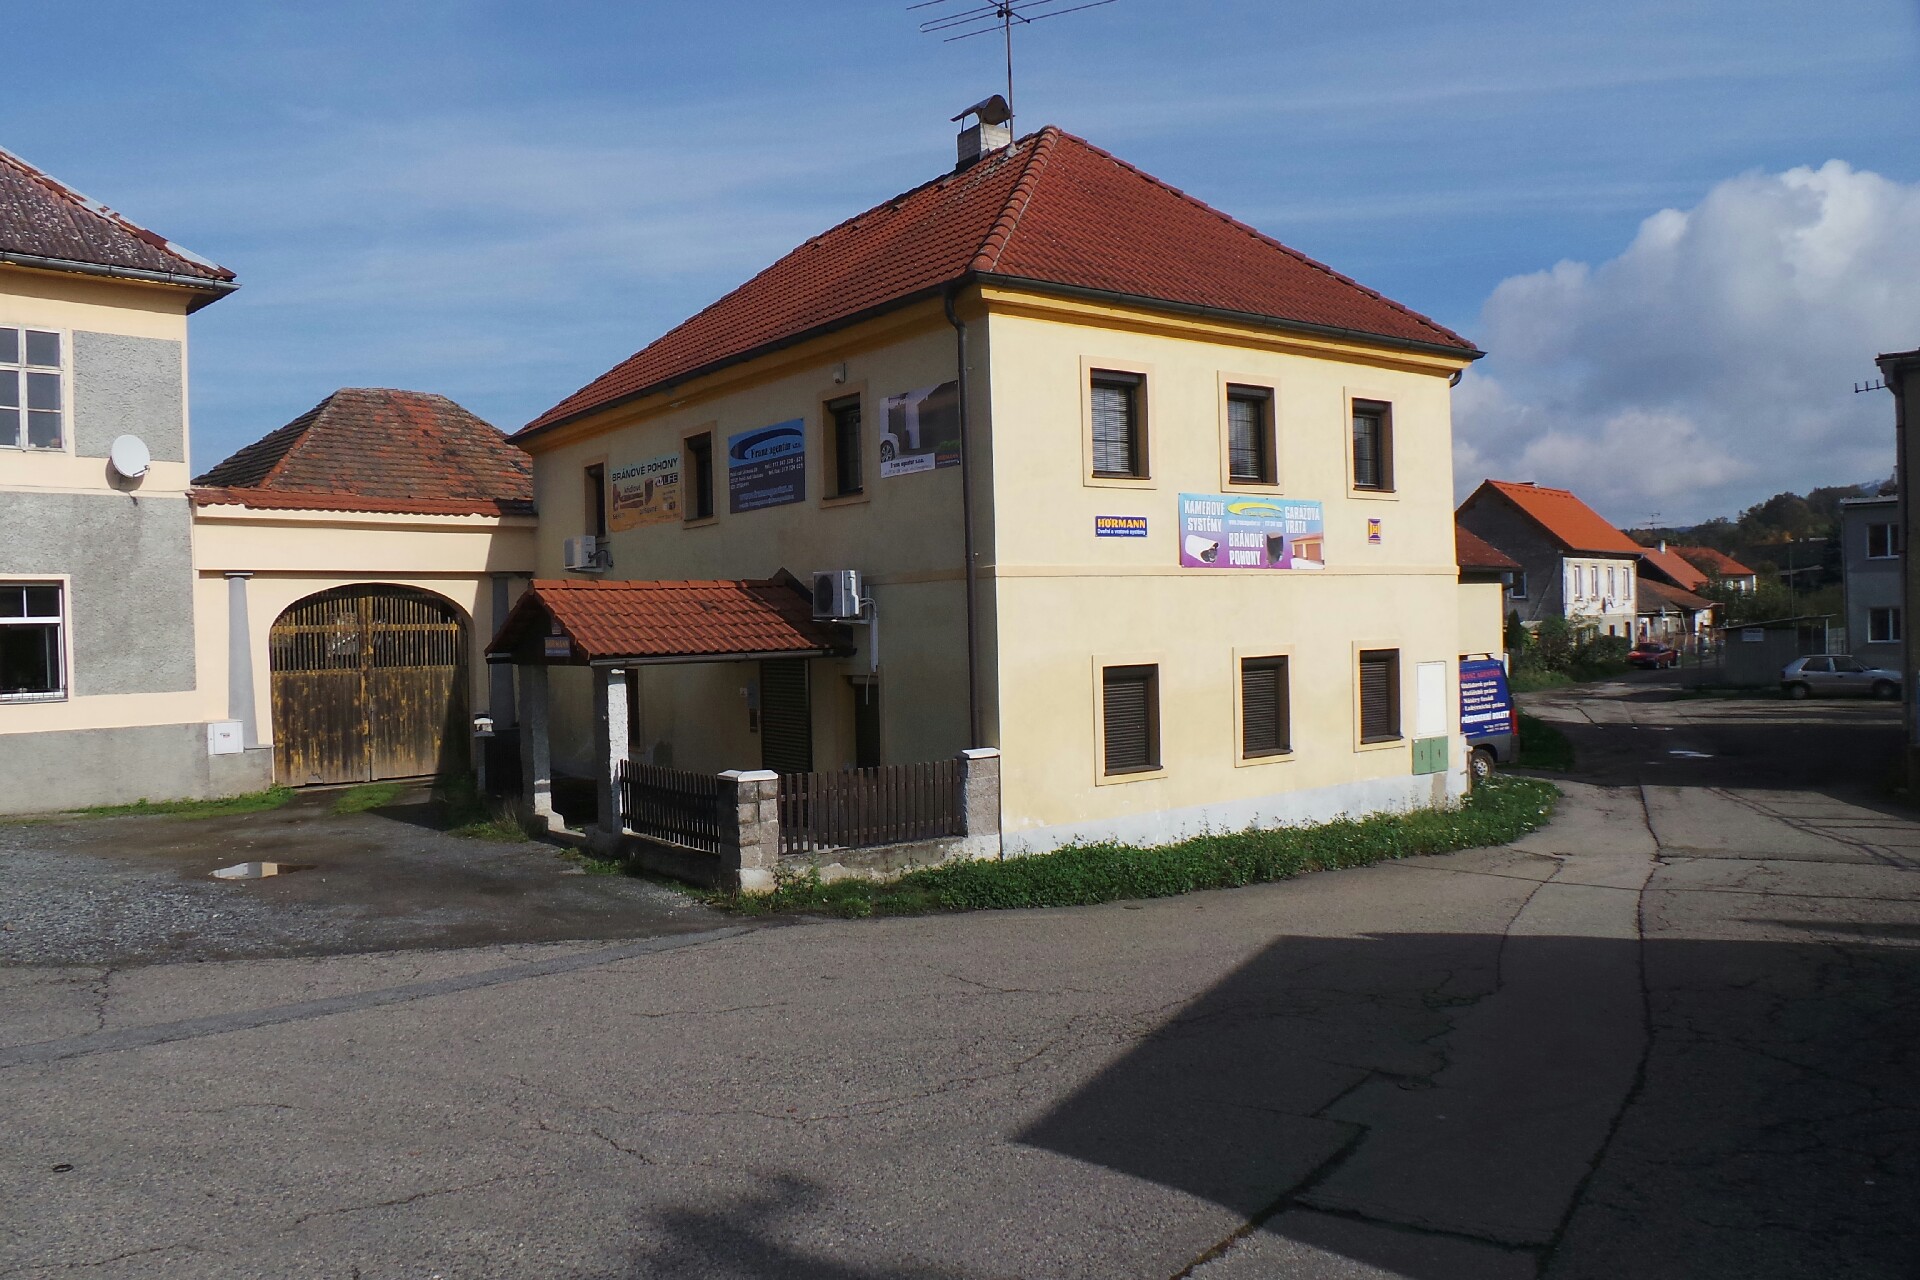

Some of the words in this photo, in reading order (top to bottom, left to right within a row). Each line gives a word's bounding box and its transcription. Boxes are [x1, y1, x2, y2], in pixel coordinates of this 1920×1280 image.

[612, 464, 646, 482] BRÁNOVÉ
[647, 457, 678, 473] POHONY
[1184, 499, 1225, 516] KAMEROVÉ
[1284, 504, 1320, 520] GARÁŽOVÁ
[1187, 516, 1222, 532] SYSTÉMY
[1285, 520, 1307, 533] VRATA
[1228, 530, 1264, 547] BRÁNOVÉ
[1229, 550, 1261, 565] POHONY
